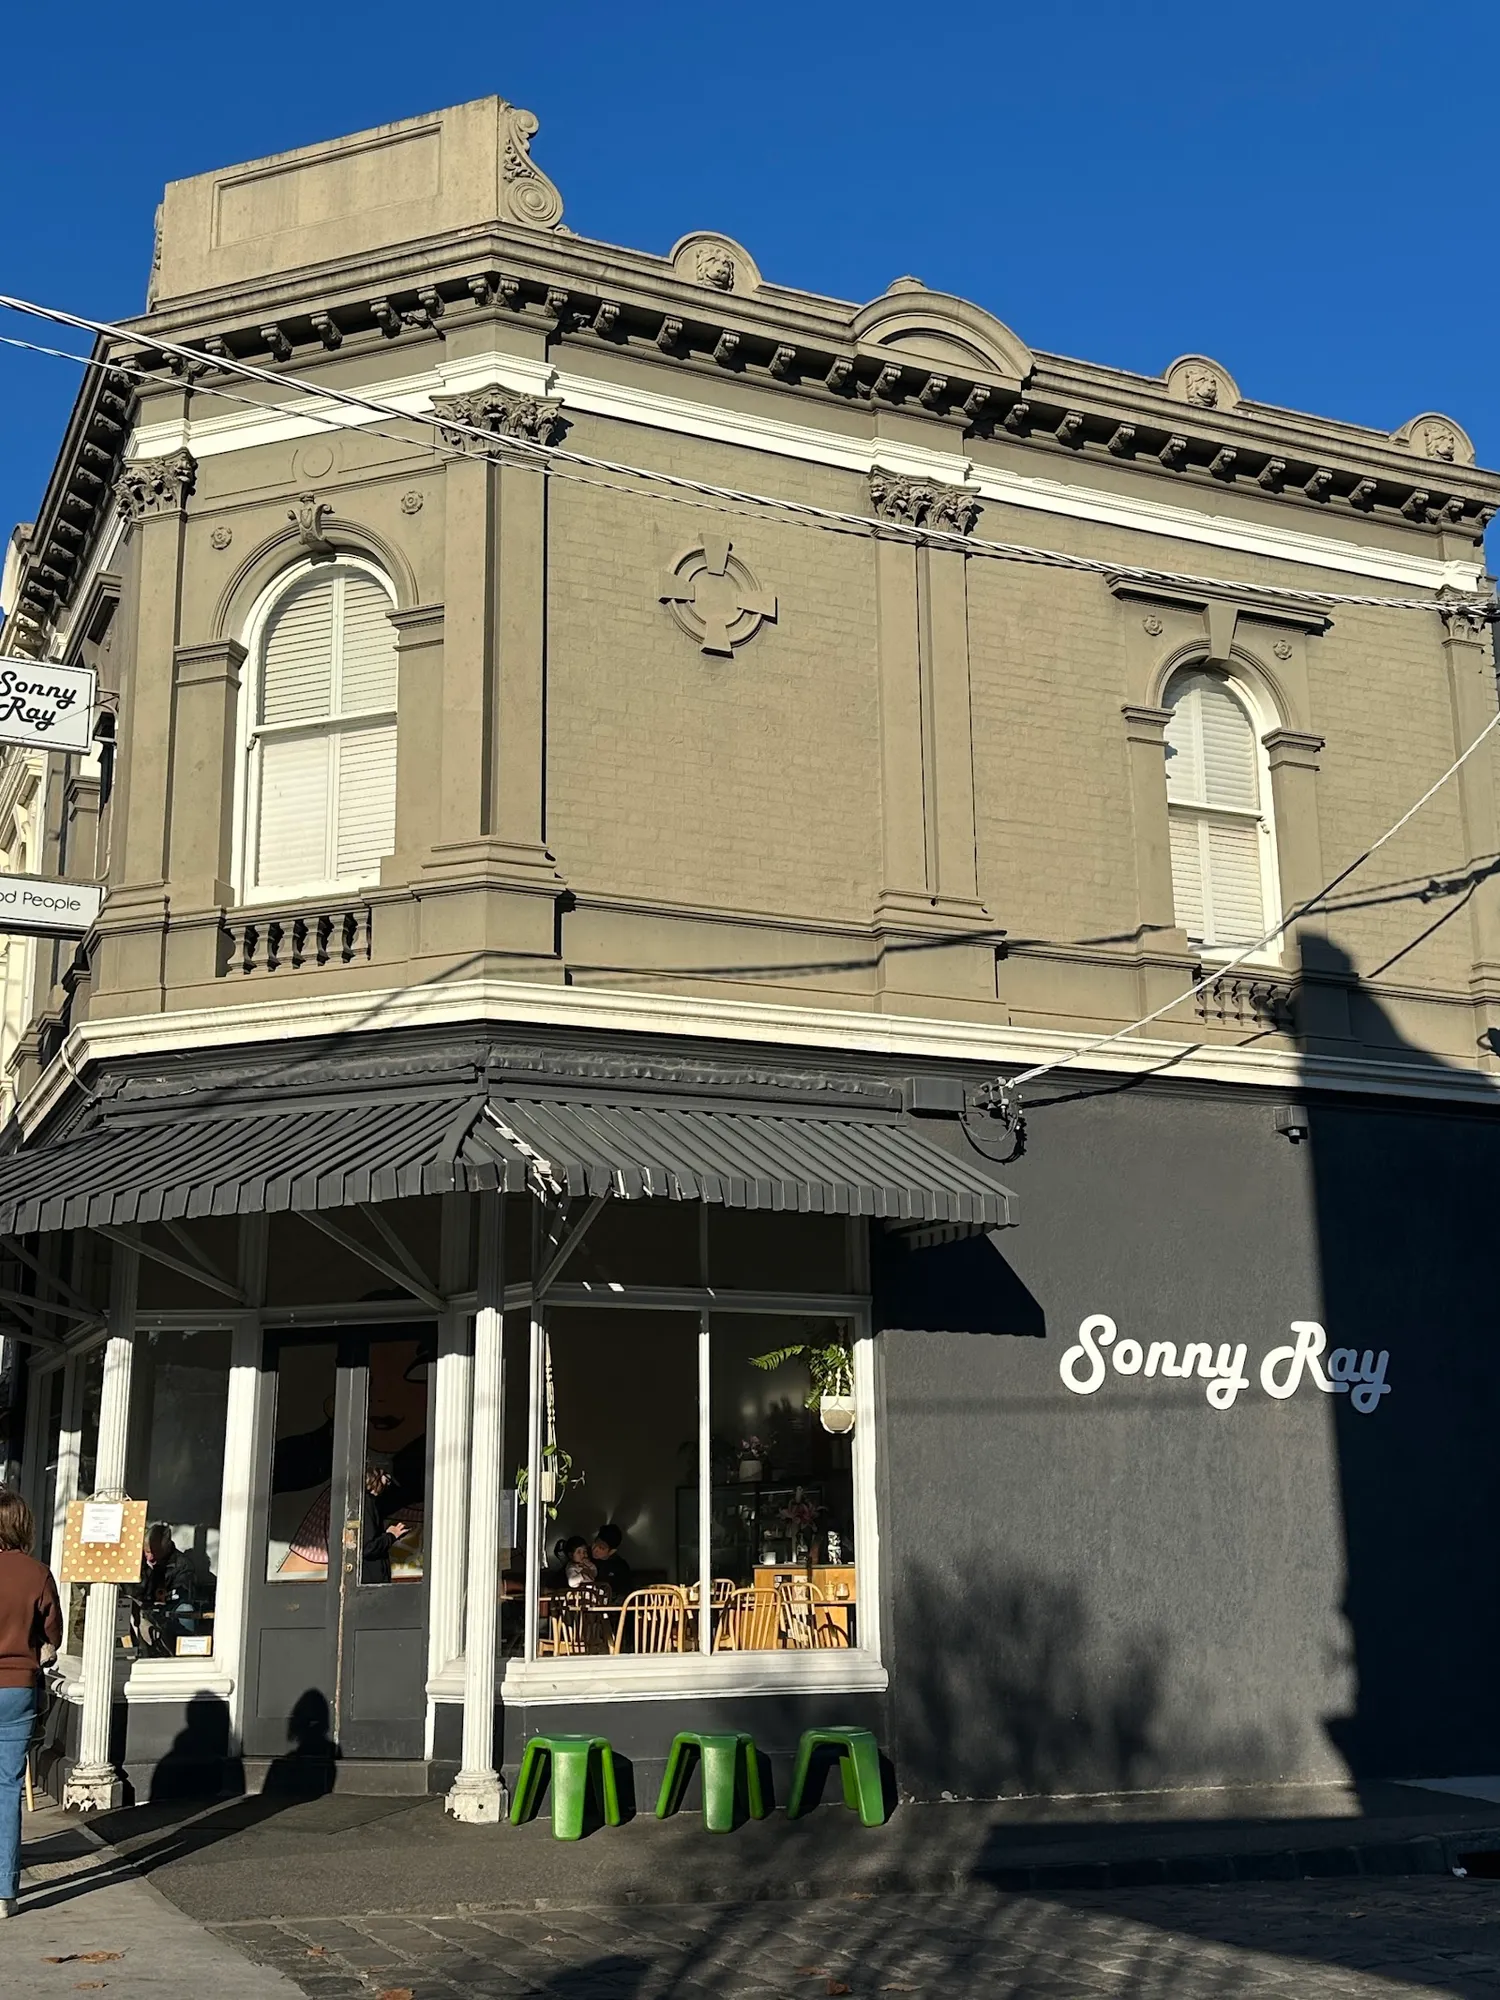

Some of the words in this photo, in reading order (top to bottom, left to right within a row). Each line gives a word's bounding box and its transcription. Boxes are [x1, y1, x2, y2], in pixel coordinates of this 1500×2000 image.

[0, 671, 77, 709] Sonny
[0, 696, 56, 731] Ray
[22, 891, 81, 912] People
[1059, 1313, 1250, 1410] Sonny
[1260, 1320, 1392, 1414] Ray
